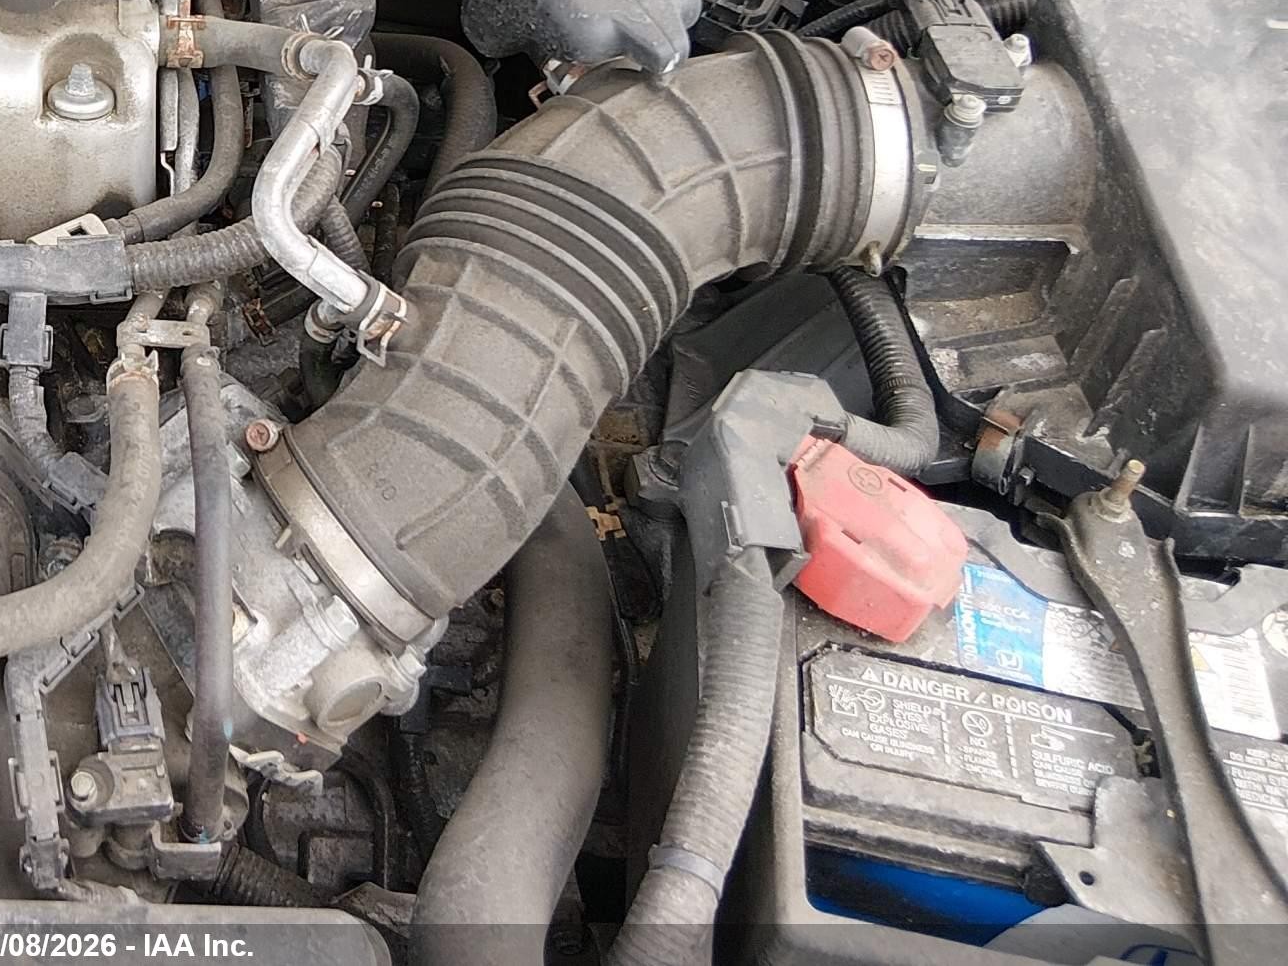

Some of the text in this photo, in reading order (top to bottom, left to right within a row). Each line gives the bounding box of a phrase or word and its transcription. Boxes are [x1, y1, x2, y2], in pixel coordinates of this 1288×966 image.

[883, 671, 972, 702] DANGER
[990, 693, 1074, 725] POISON
[892, 698, 932, 715] SHIELD
[868, 712, 929, 734] EXPLOSIVE
[893, 709, 924, 723] EYES
[869, 724, 909, 740] GASES
[969, 736, 987, 749] NO
[1032, 749, 1114, 775] SULFURIC ACID
